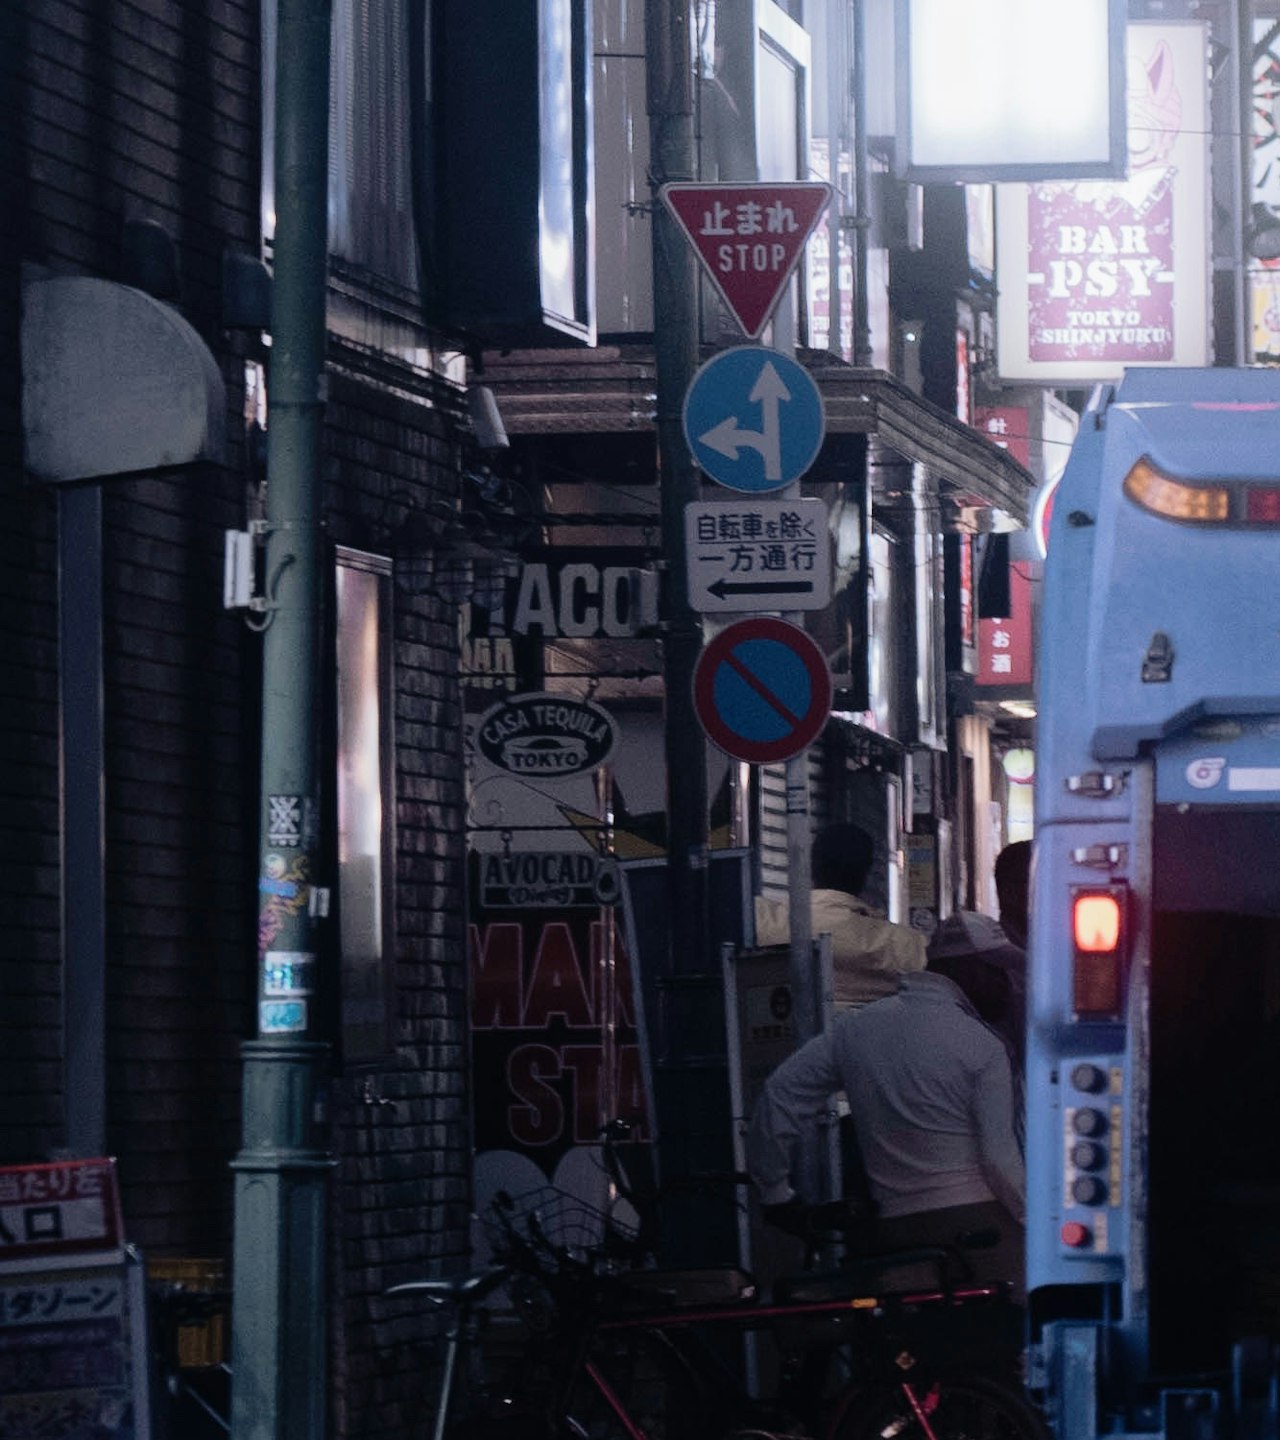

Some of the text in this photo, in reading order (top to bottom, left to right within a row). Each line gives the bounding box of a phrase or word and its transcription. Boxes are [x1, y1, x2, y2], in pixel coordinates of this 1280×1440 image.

[700, 201, 798, 238] 止まれ
[1058, 224, 1150, 256] BAR
[717, 243, 788, 274] STOP
[1047, 257, 1161, 298] PSY
[1066, 308, 1141, 328] TOKYO
[1041, 327, 1166, 345] SHINJYUKU
[696, 511, 817, 544] 自転車を除く
[698, 545, 817, 576] 一方通行
[481, 705, 608, 745] CASA TEQUILA
[511, 751, 579, 767] TOKYO
